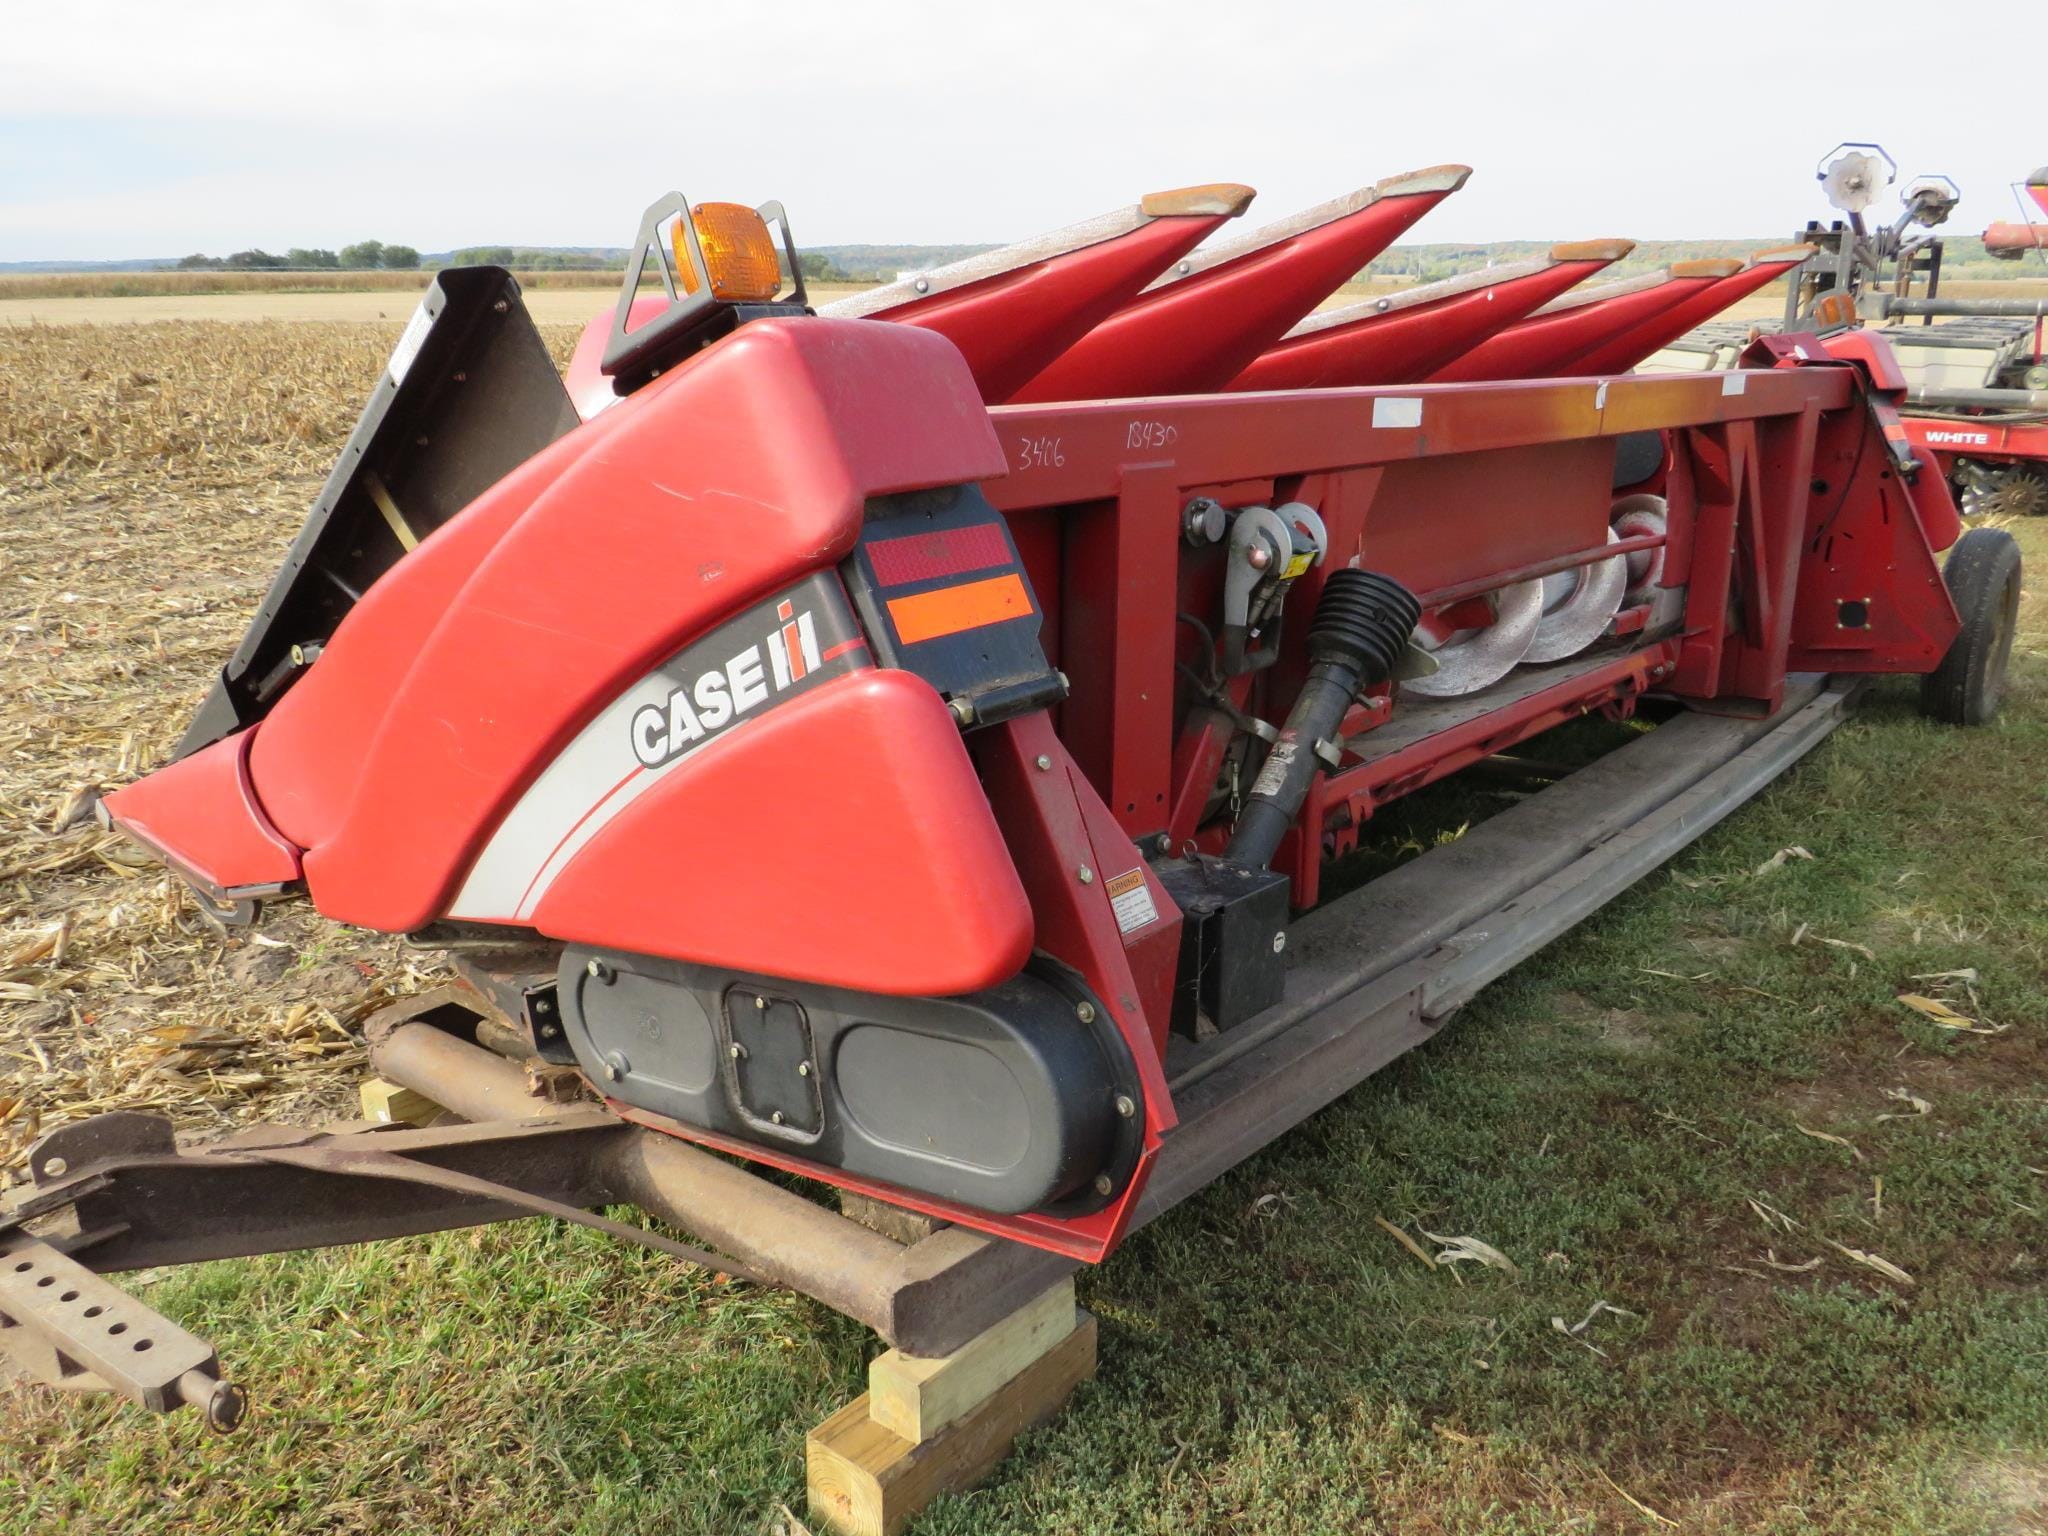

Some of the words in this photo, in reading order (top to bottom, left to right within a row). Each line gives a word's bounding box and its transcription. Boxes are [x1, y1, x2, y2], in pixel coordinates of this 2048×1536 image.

[1127, 421, 1177, 449] 18430
[1925, 431, 1988, 445] WHITE
[632, 644, 769, 765] CASE
[1108, 875, 1140, 894] ARNING
